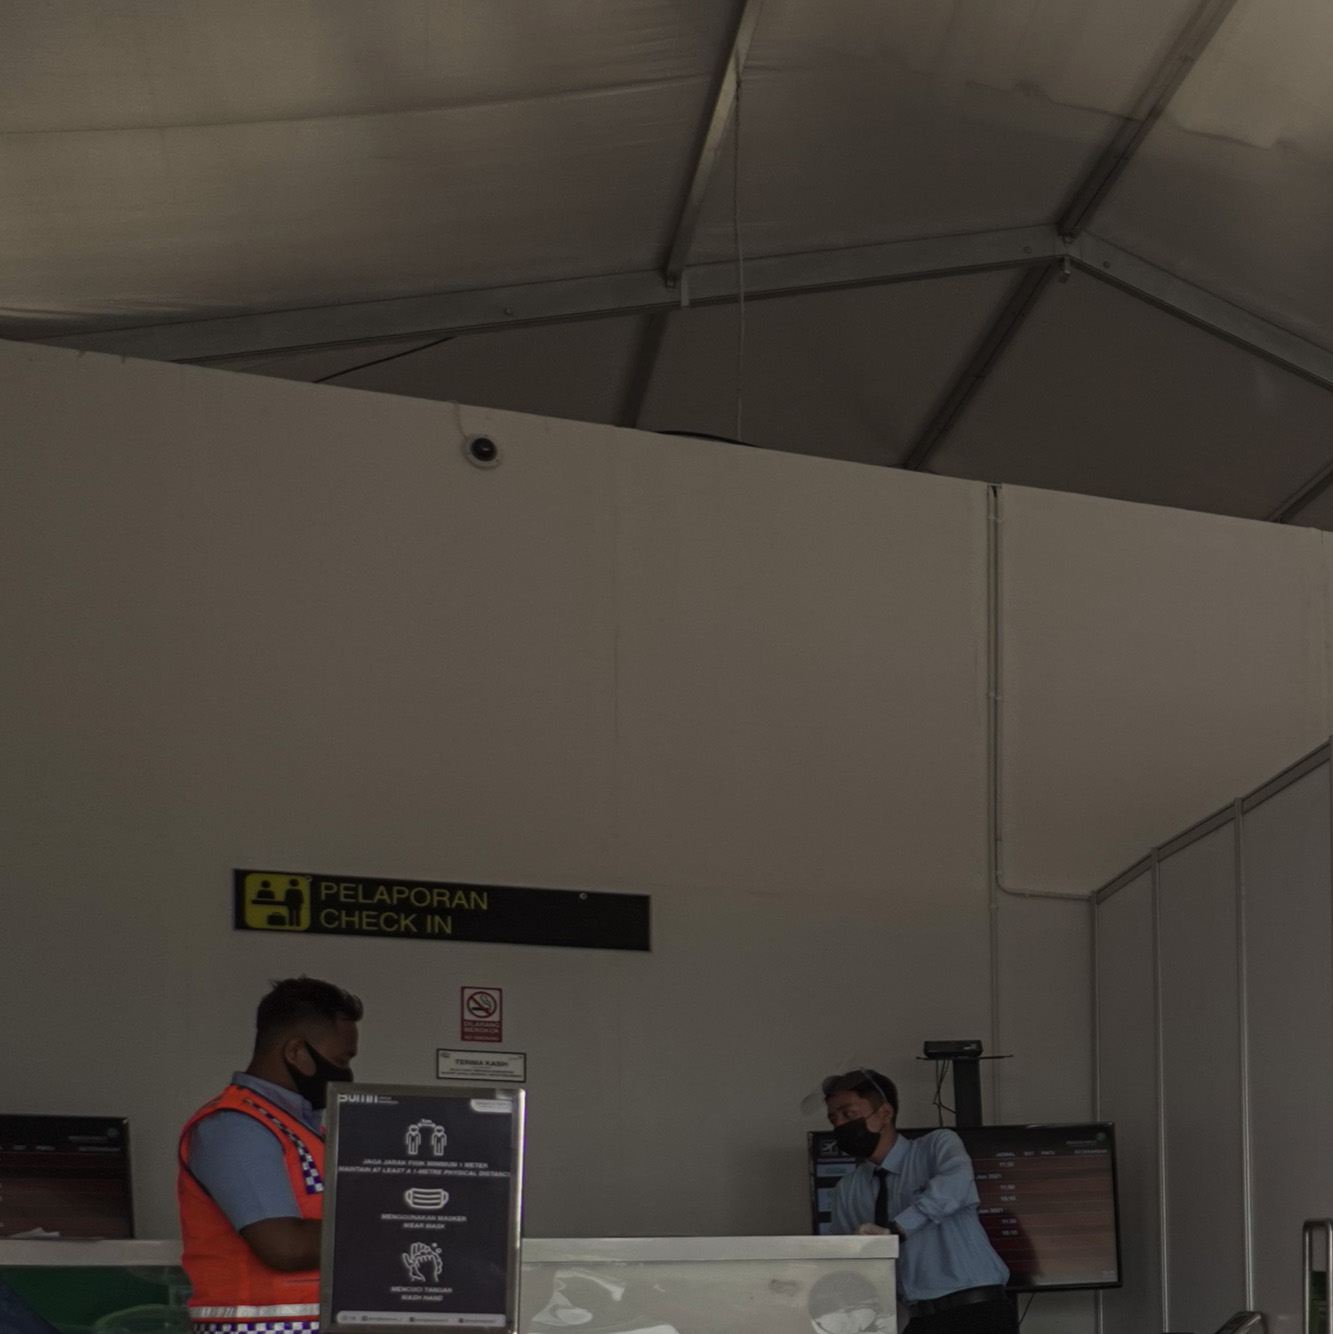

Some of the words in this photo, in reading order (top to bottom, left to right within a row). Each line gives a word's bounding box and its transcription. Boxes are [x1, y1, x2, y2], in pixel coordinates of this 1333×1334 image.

[321, 882, 489, 911] PELAPORAN
[320, 909, 417, 933] CHECK
[427, 914, 453, 935] IN
